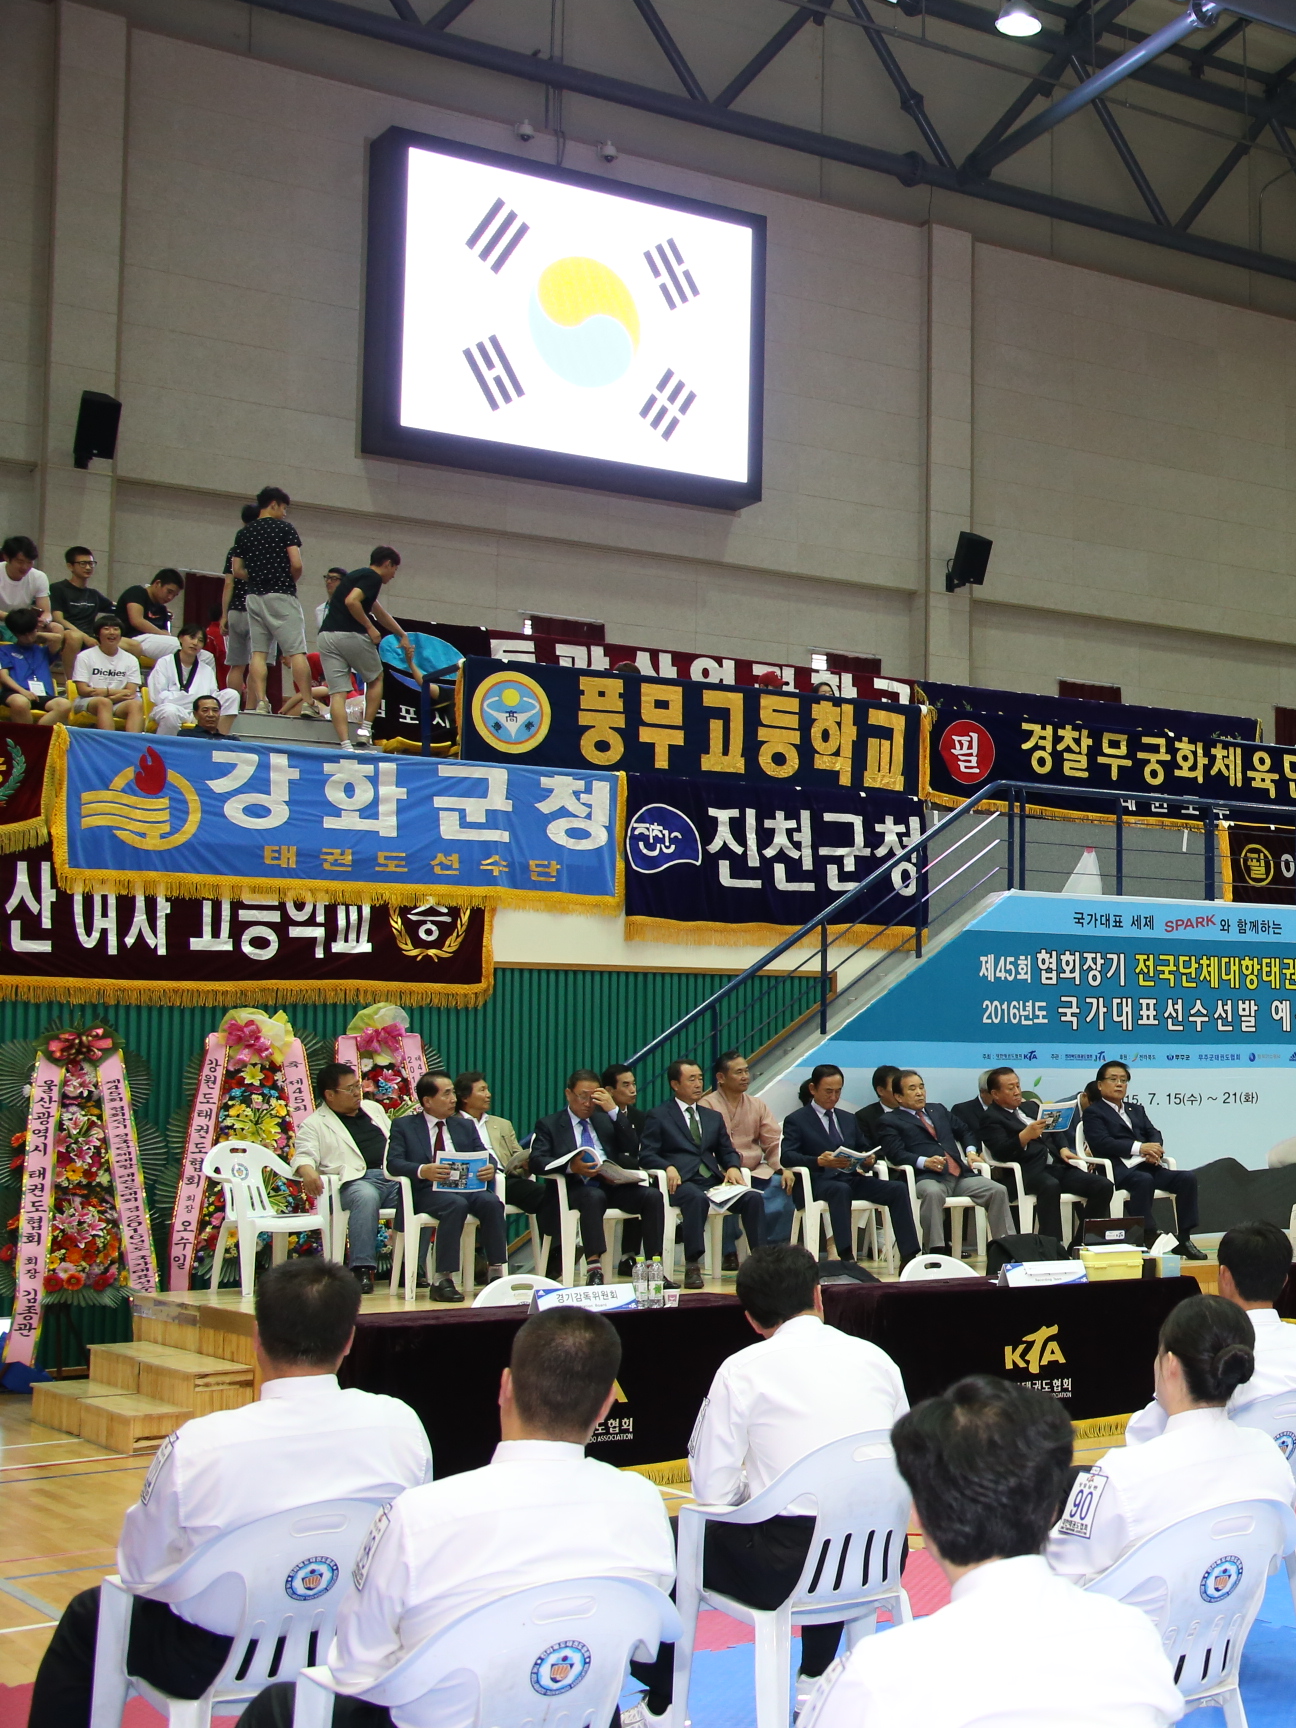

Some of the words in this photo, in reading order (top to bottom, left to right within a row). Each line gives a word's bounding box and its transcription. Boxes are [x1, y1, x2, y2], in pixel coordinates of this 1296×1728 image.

[92, 667, 127, 678] Dickies
[578, 675, 906, 792] 풍무고등학교
[951, 732, 981, 773] 필
[205, 750, 611, 850] 강화군청
[263, 845, 562, 882] 태권도선수단
[706, 807, 921, 897] 진천군청
[1247, 852, 1267, 879] 필
[1073, 911, 1124, 930] 국가대표
[1131, 914, 1155, 932] 세제
[1164, 914, 1217, 934] SPARK
[1219, 917, 1231, 934] 와
[1237, 918, 1283, 936] 함께하는
[978, 953, 1032, 984] 제45회
[1036, 948, 1126, 988] 협회장기
[982, 1000, 1048, 1026] 2016년도
[1057, 996, 1258, 1033] 국가대표선수선발
[1023, 1050, 1038, 1061] KTA
[29, 1079, 56, 1157] 울산광역시
[1148, 1093, 1160, 1106] 7.
[1166, 1092, 1203, 1107] 15(수)
[1222, 1092, 1259, 1106] 21(화)
[22, 1166, 47, 1247] 태권도협회
[556, 1289, 619, 1304] 경기감독위원회
[1005, 1324, 1067, 1374] KTA
[597, 1433, 634, 1443] ASSOCIATION
[1069, 1488, 1094, 1521] 90
